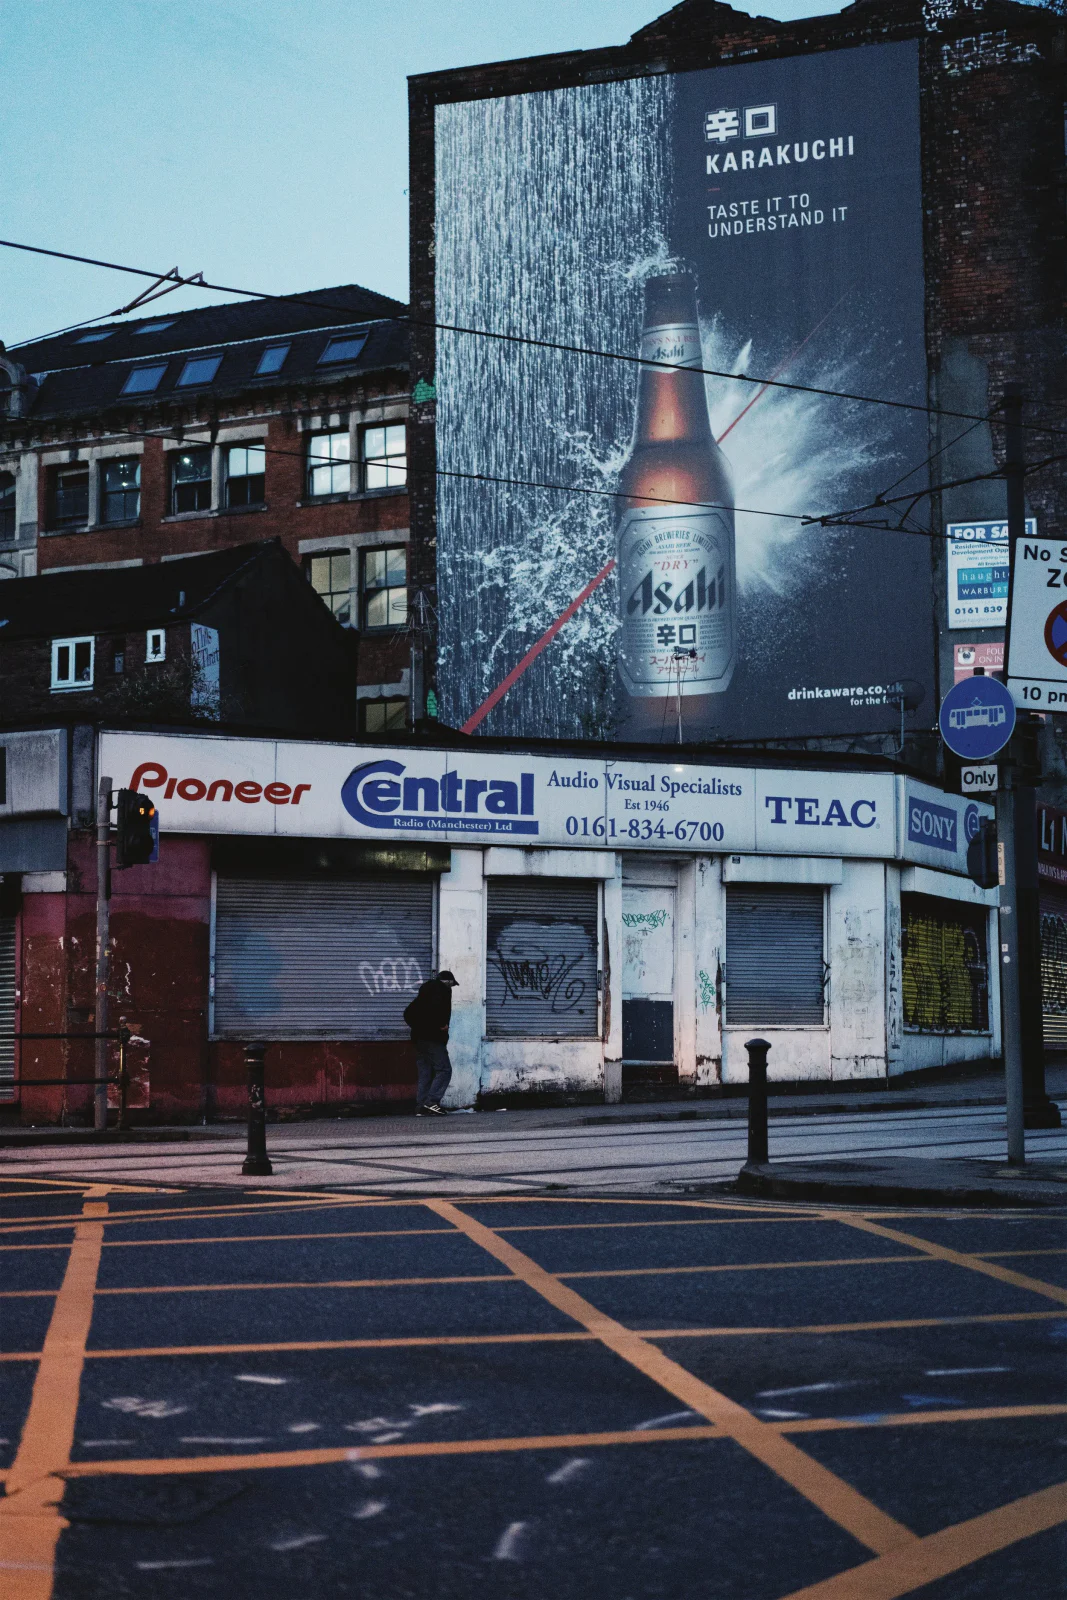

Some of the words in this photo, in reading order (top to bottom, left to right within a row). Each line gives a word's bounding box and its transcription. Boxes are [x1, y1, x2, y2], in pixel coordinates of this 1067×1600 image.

[704, 103, 777, 143] 辛口
[706, 135, 854, 175] KARAKUCHI
[707, 200, 759, 219] TASTE
[767, 196, 782, 212] IT
[788, 193, 810, 208] TO
[708, 210, 824, 238] UNDERSTAND
[832, 206, 847, 222] IT
[652, 344, 684, 360] Asahi
[637, 539, 653, 557] ASAHI
[654, 530, 691, 543] BREWERIES
[693, 533, 714, 553] LIMITED
[954, 527, 987, 540] FOR
[1024, 545, 1051, 561] No
[962, 570, 1009, 582] haught
[1047, 568, 1067, 588] Z
[627, 565, 725, 616] Asahi
[955, 607, 979, 615] 0161
[984, 605, 1002, 613] 839
[657, 624, 697, 646] 辛口
[979, 656, 992, 664] ON
[788, 682, 904, 700] drinkaware.co.uk
[850, 697, 863, 706] for
[866, 696, 881, 705] the
[1022, 686, 1041, 701] 10
[129, 762, 312, 804] Pioneer
[547, 770, 599, 789] Audio
[603, 772, 656, 792] Visual
[660, 776, 742, 798] Specialists
[963, 770, 996, 787] Only
[341, 759, 534, 820] Central
[624, 799, 641, 810] Est
[644, 800, 670, 811] 1946
[765, 796, 877, 828] TEAC
[393, 818, 424, 828] Radio
[426, 819, 492, 831] (Manchester)
[495, 822, 513, 831] Ltd
[565, 815, 725, 842] 0161-834-6700
[911, 808, 955, 842] SONY
